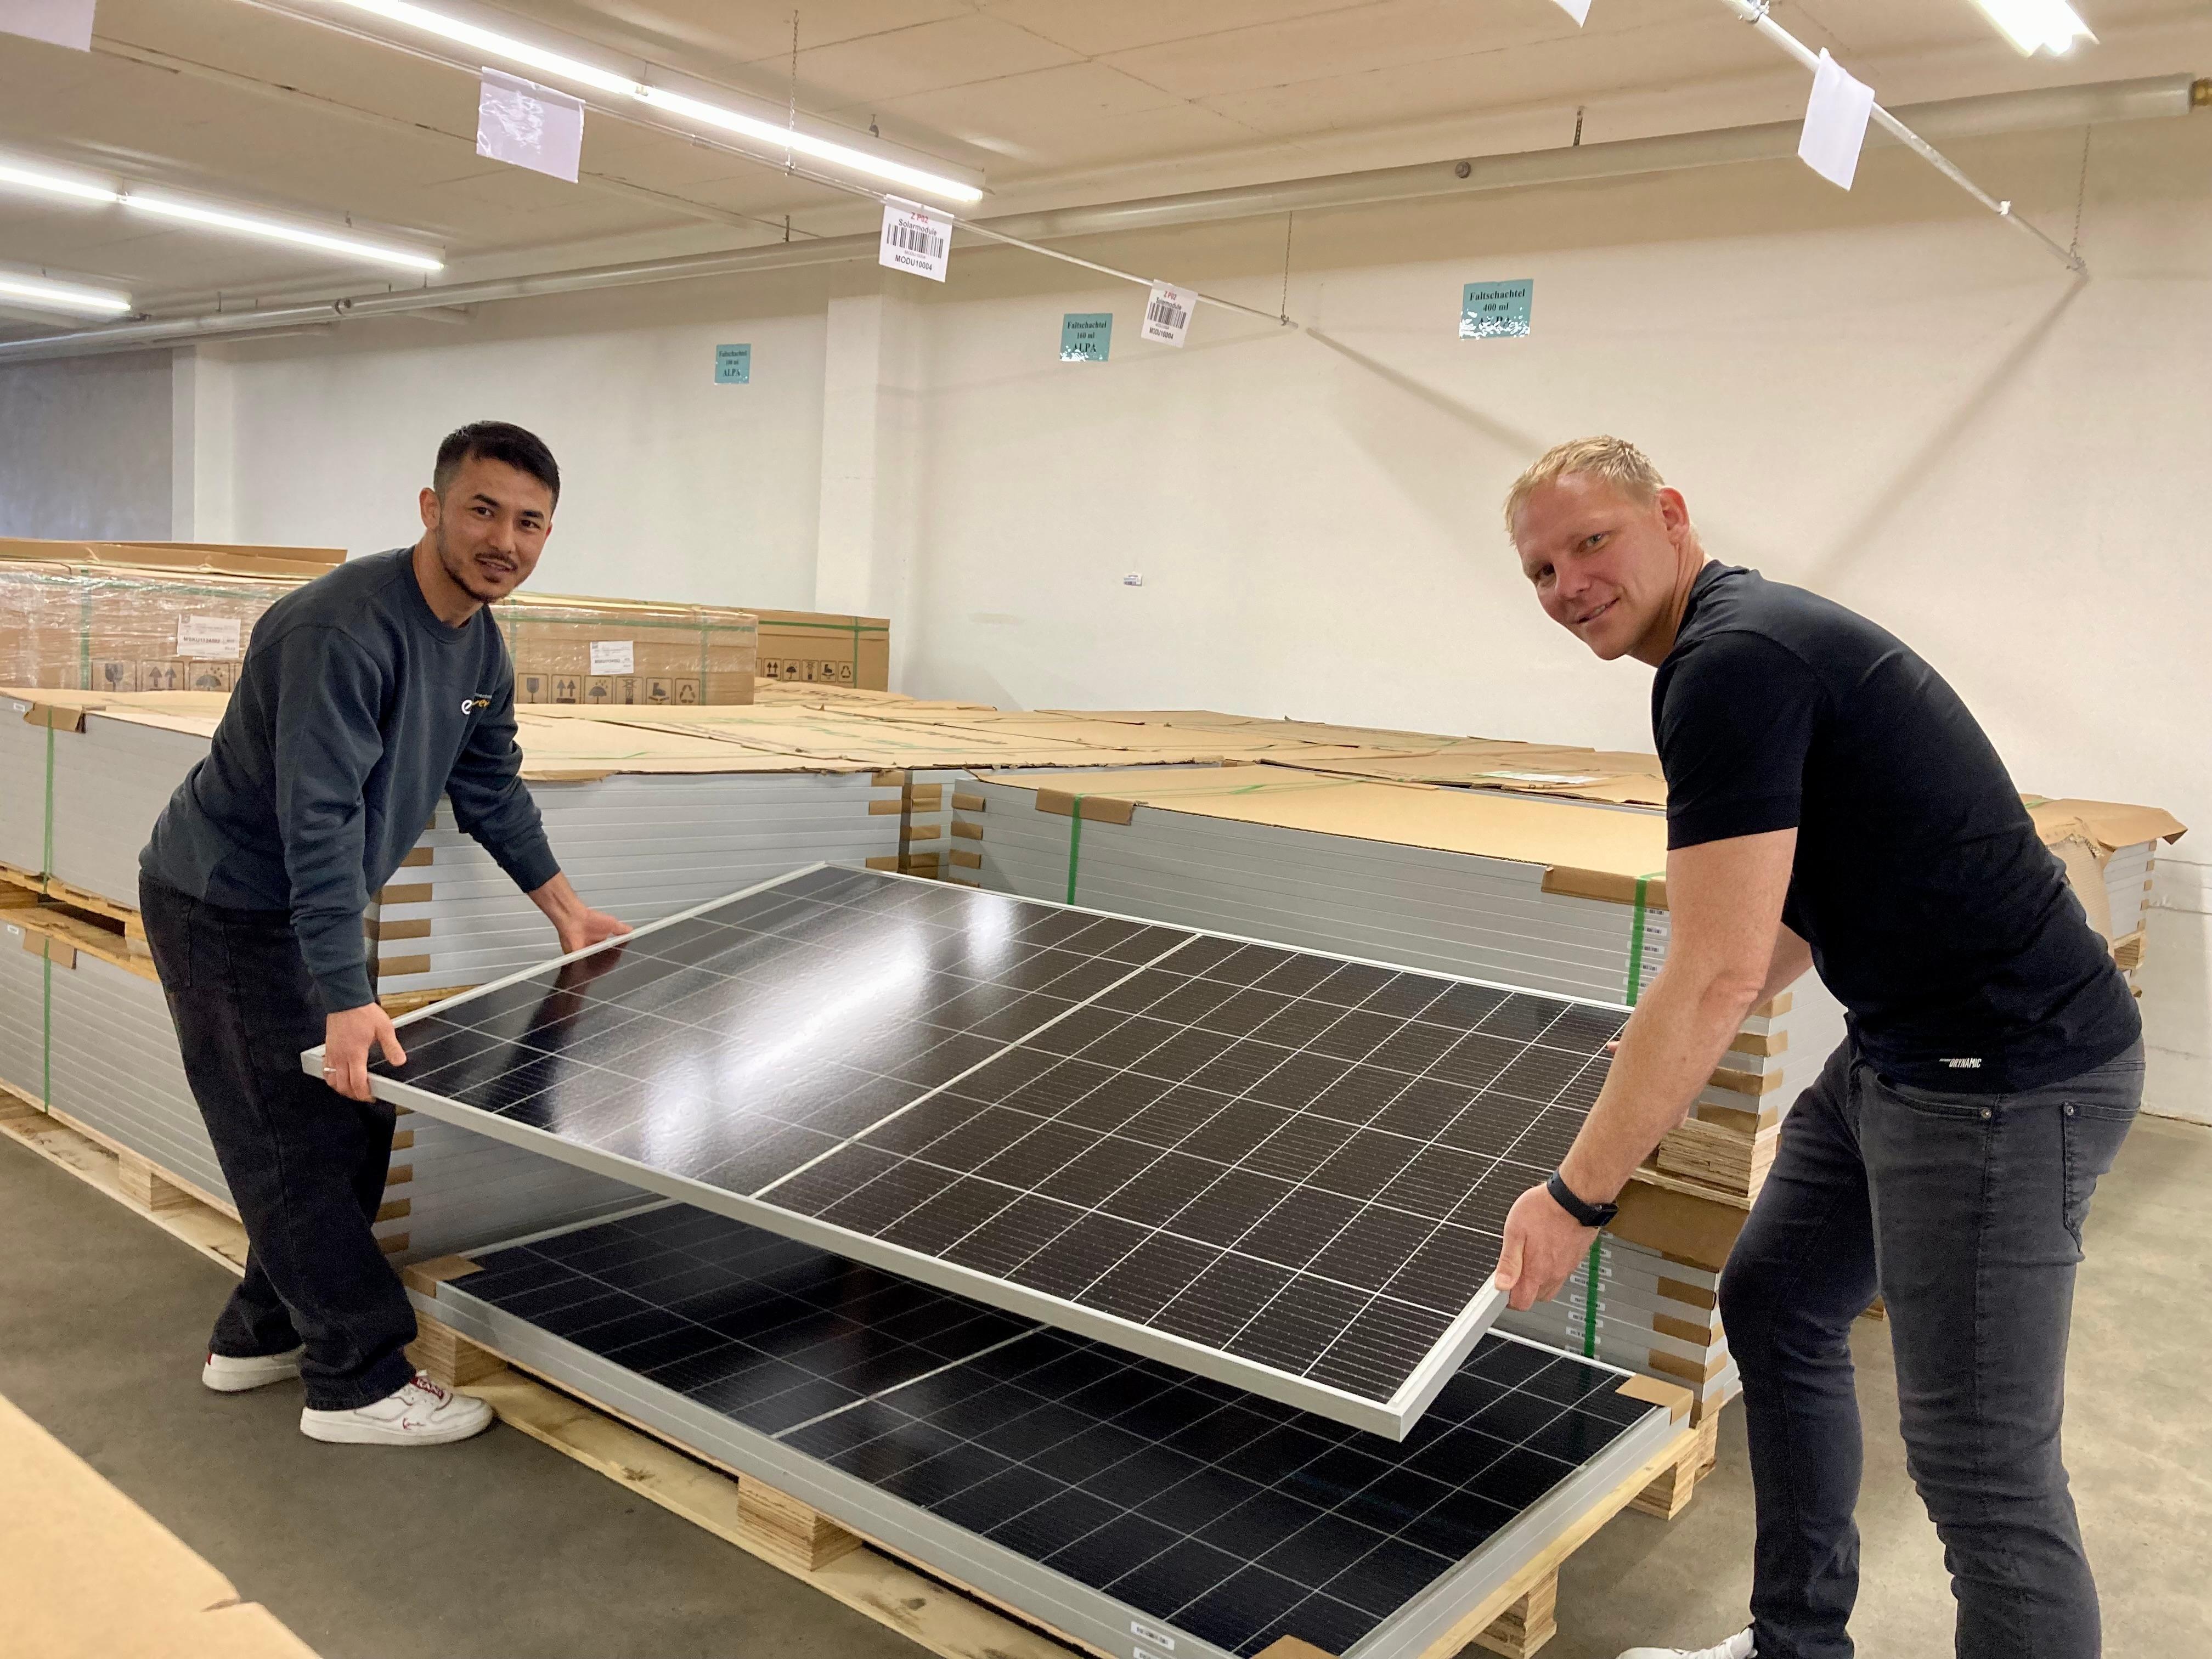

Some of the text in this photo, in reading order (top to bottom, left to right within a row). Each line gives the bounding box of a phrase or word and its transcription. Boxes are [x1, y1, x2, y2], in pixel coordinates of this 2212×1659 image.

[917, 213, 929, 223] P02
[898, 218, 937, 236] Solarmodule
[895, 254, 932, 270] MODU10004
[1470, 289, 1525, 301] Faltschachtel
[1483, 302, 1509, 312] 400 ml
[1067, 321, 1107, 329] Faltschachtel
[1073, 343, 1096, 353] ALPA
[723, 368, 740, 377] ALPA
[1949, 1057, 1982, 1068] DRYNAMIC
